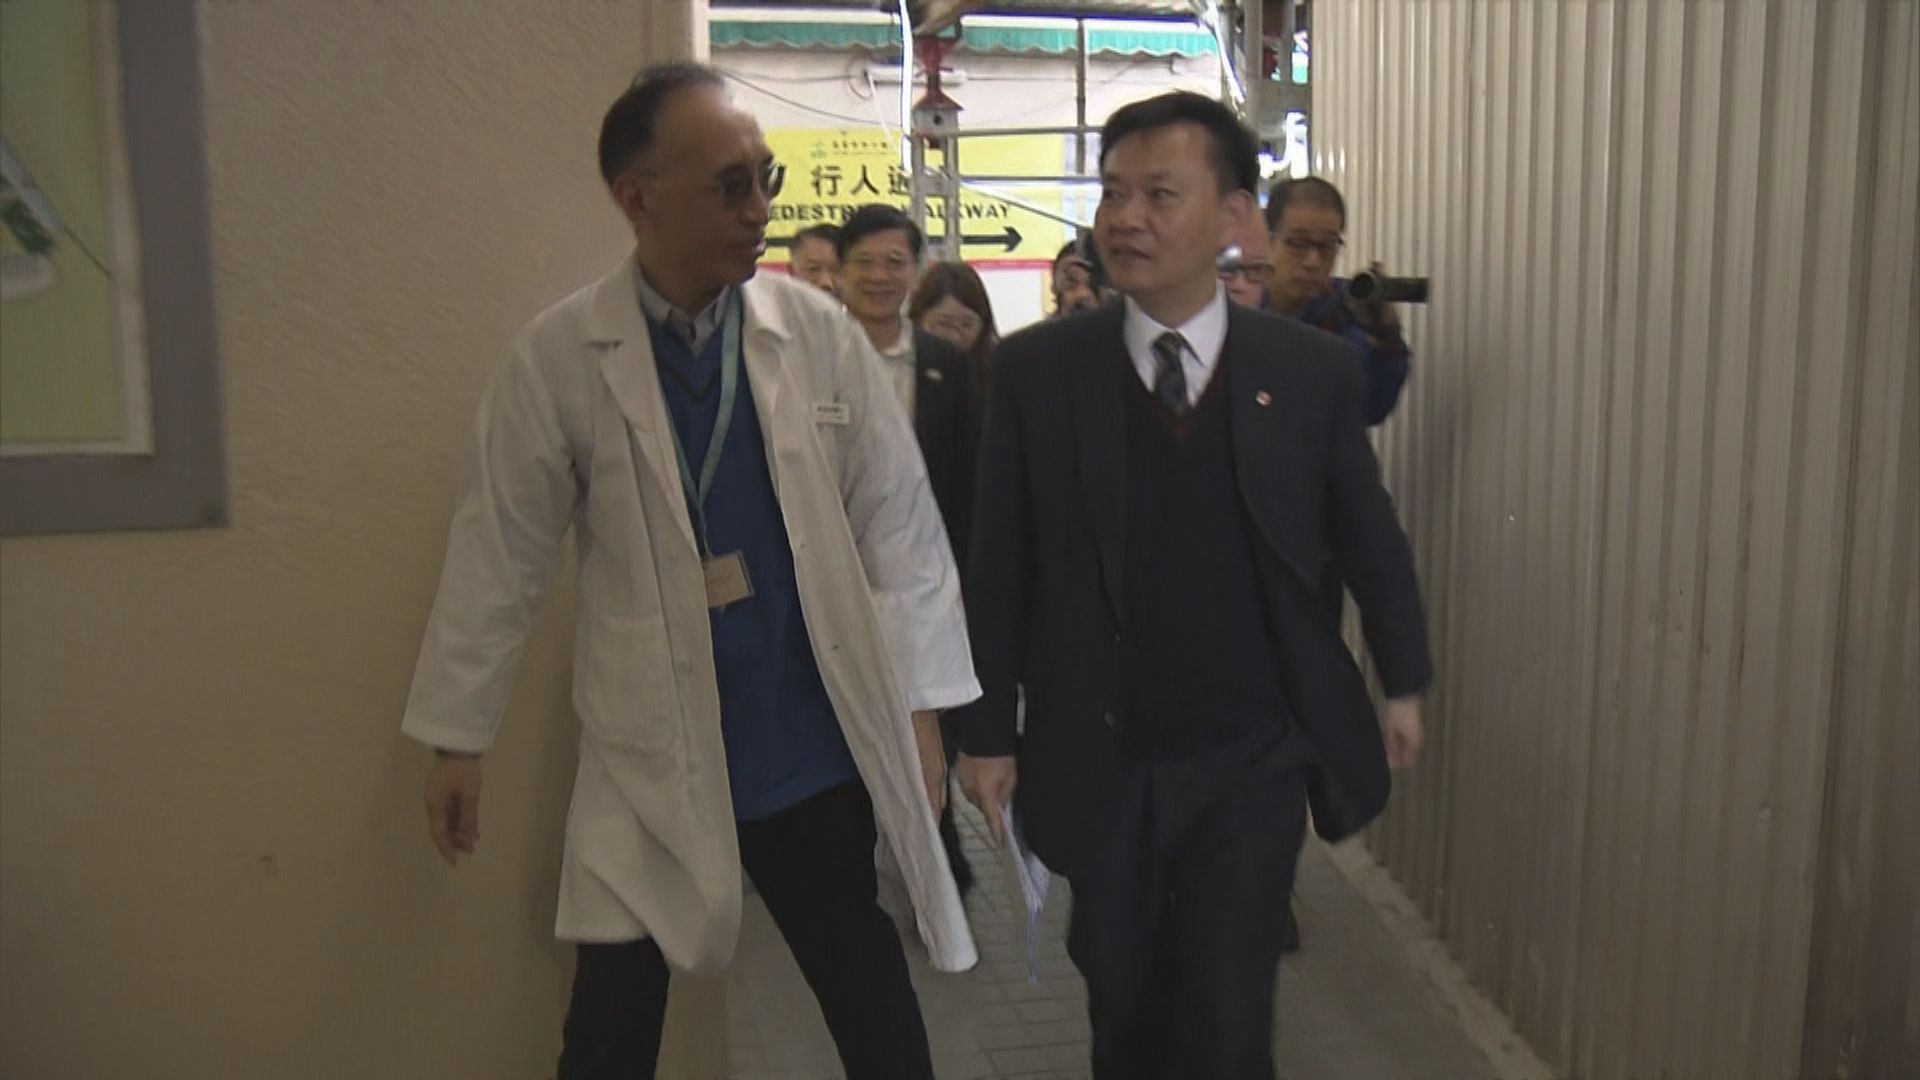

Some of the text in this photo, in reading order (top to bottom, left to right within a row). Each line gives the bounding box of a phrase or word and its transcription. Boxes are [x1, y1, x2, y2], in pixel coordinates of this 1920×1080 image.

[811, 165, 914, 197] 行人通
[768, 203, 859, 221] EDESTR
